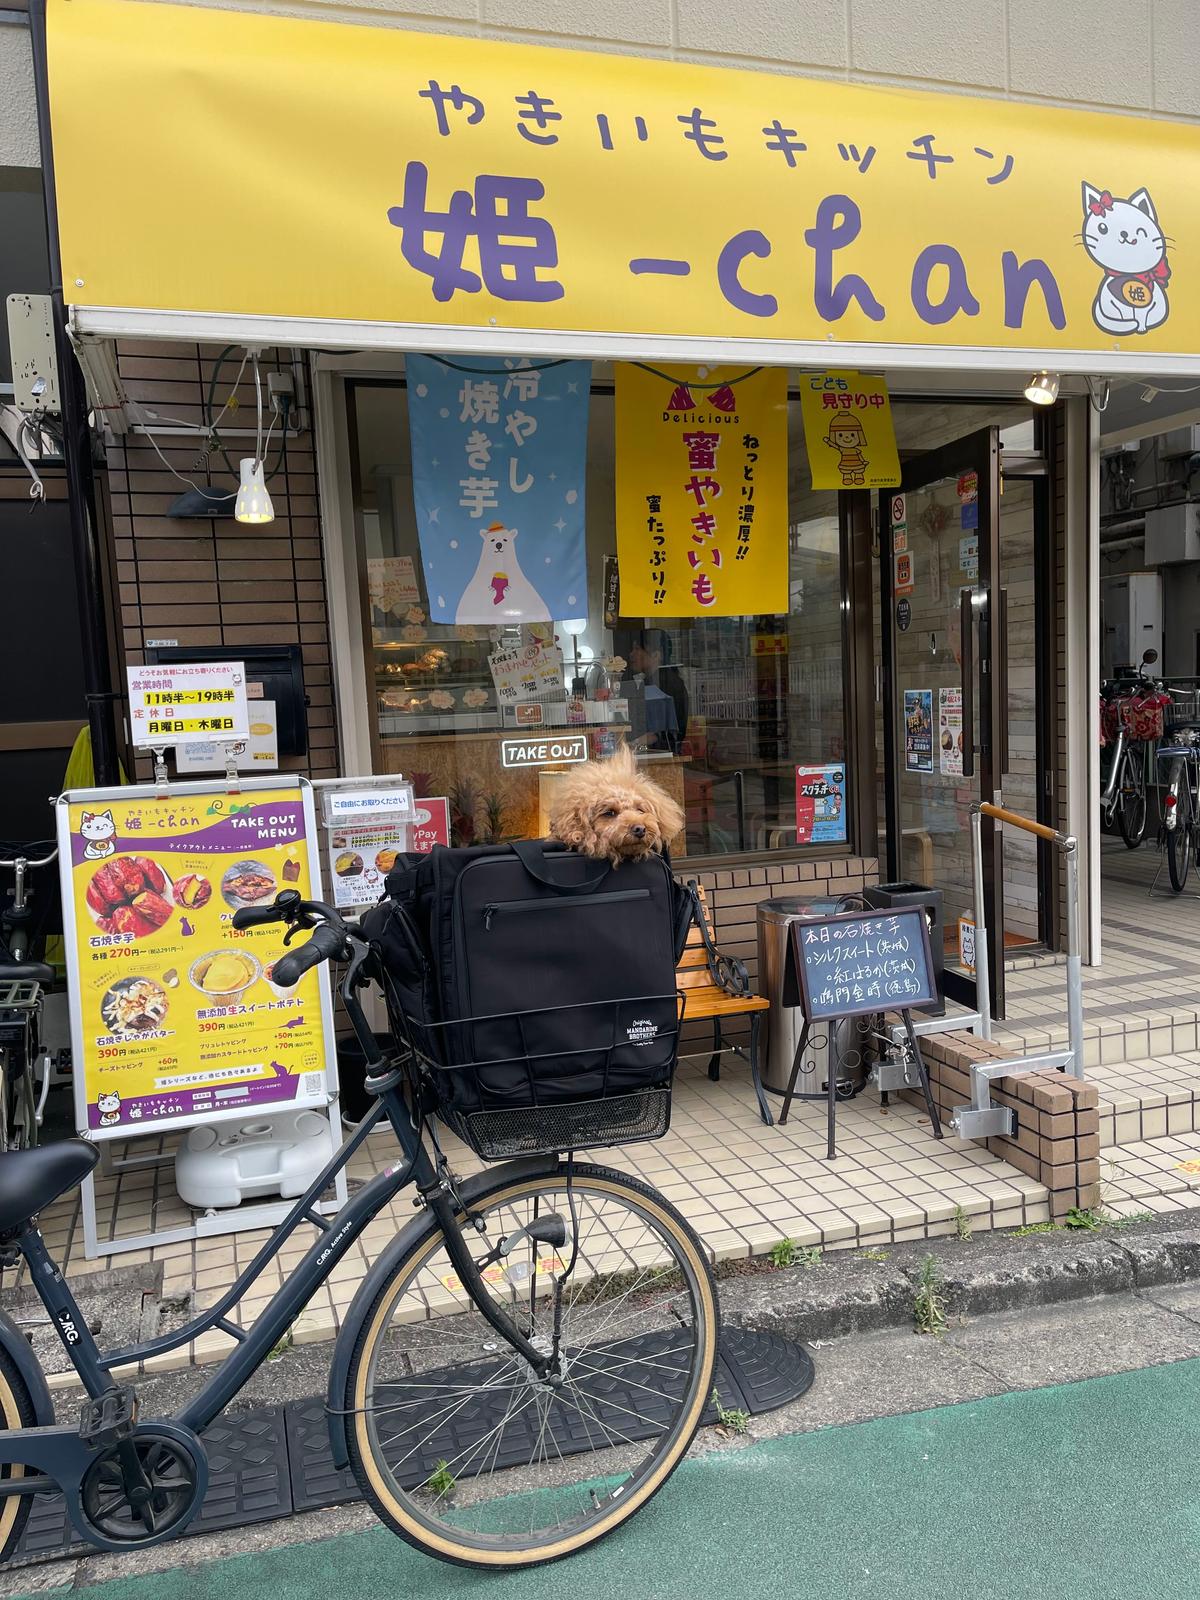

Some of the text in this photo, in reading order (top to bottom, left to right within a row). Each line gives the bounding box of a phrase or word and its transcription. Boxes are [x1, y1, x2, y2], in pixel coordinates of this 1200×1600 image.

[418, 79, 1014, 184] やきいもキッチン
[810, 377, 848, 391] こども
[822, 393, 885, 410] 見守り中
[662, 411, 740, 424] Delicious
[503, 358, 542, 494] 冷やし
[458, 379, 499, 519] 焼き芋
[682, 430, 722, 607] 蜜やきいも
[131, 679, 173, 691] 営業時間
[508, 743, 582, 761] TAKE OUT
[333, 797, 406, 808] ご自由にお取りください
[128, 806, 195, 817] やきいもキッチン
[231, 814, 296, 828] TAKE OUT
[257, 827, 297, 839] MENU
[805, 915, 901, 944] 本日の石焼き芋
[90, 933, 134, 947] 石焼き芋
[197, 998, 304, 1020] 無添加生スイートポテト
[198, 1022, 226, 1033] 390円
[96, 1030, 176, 1046] 石焼きじゃがバター
[97, 1048, 127, 1059] 390円
